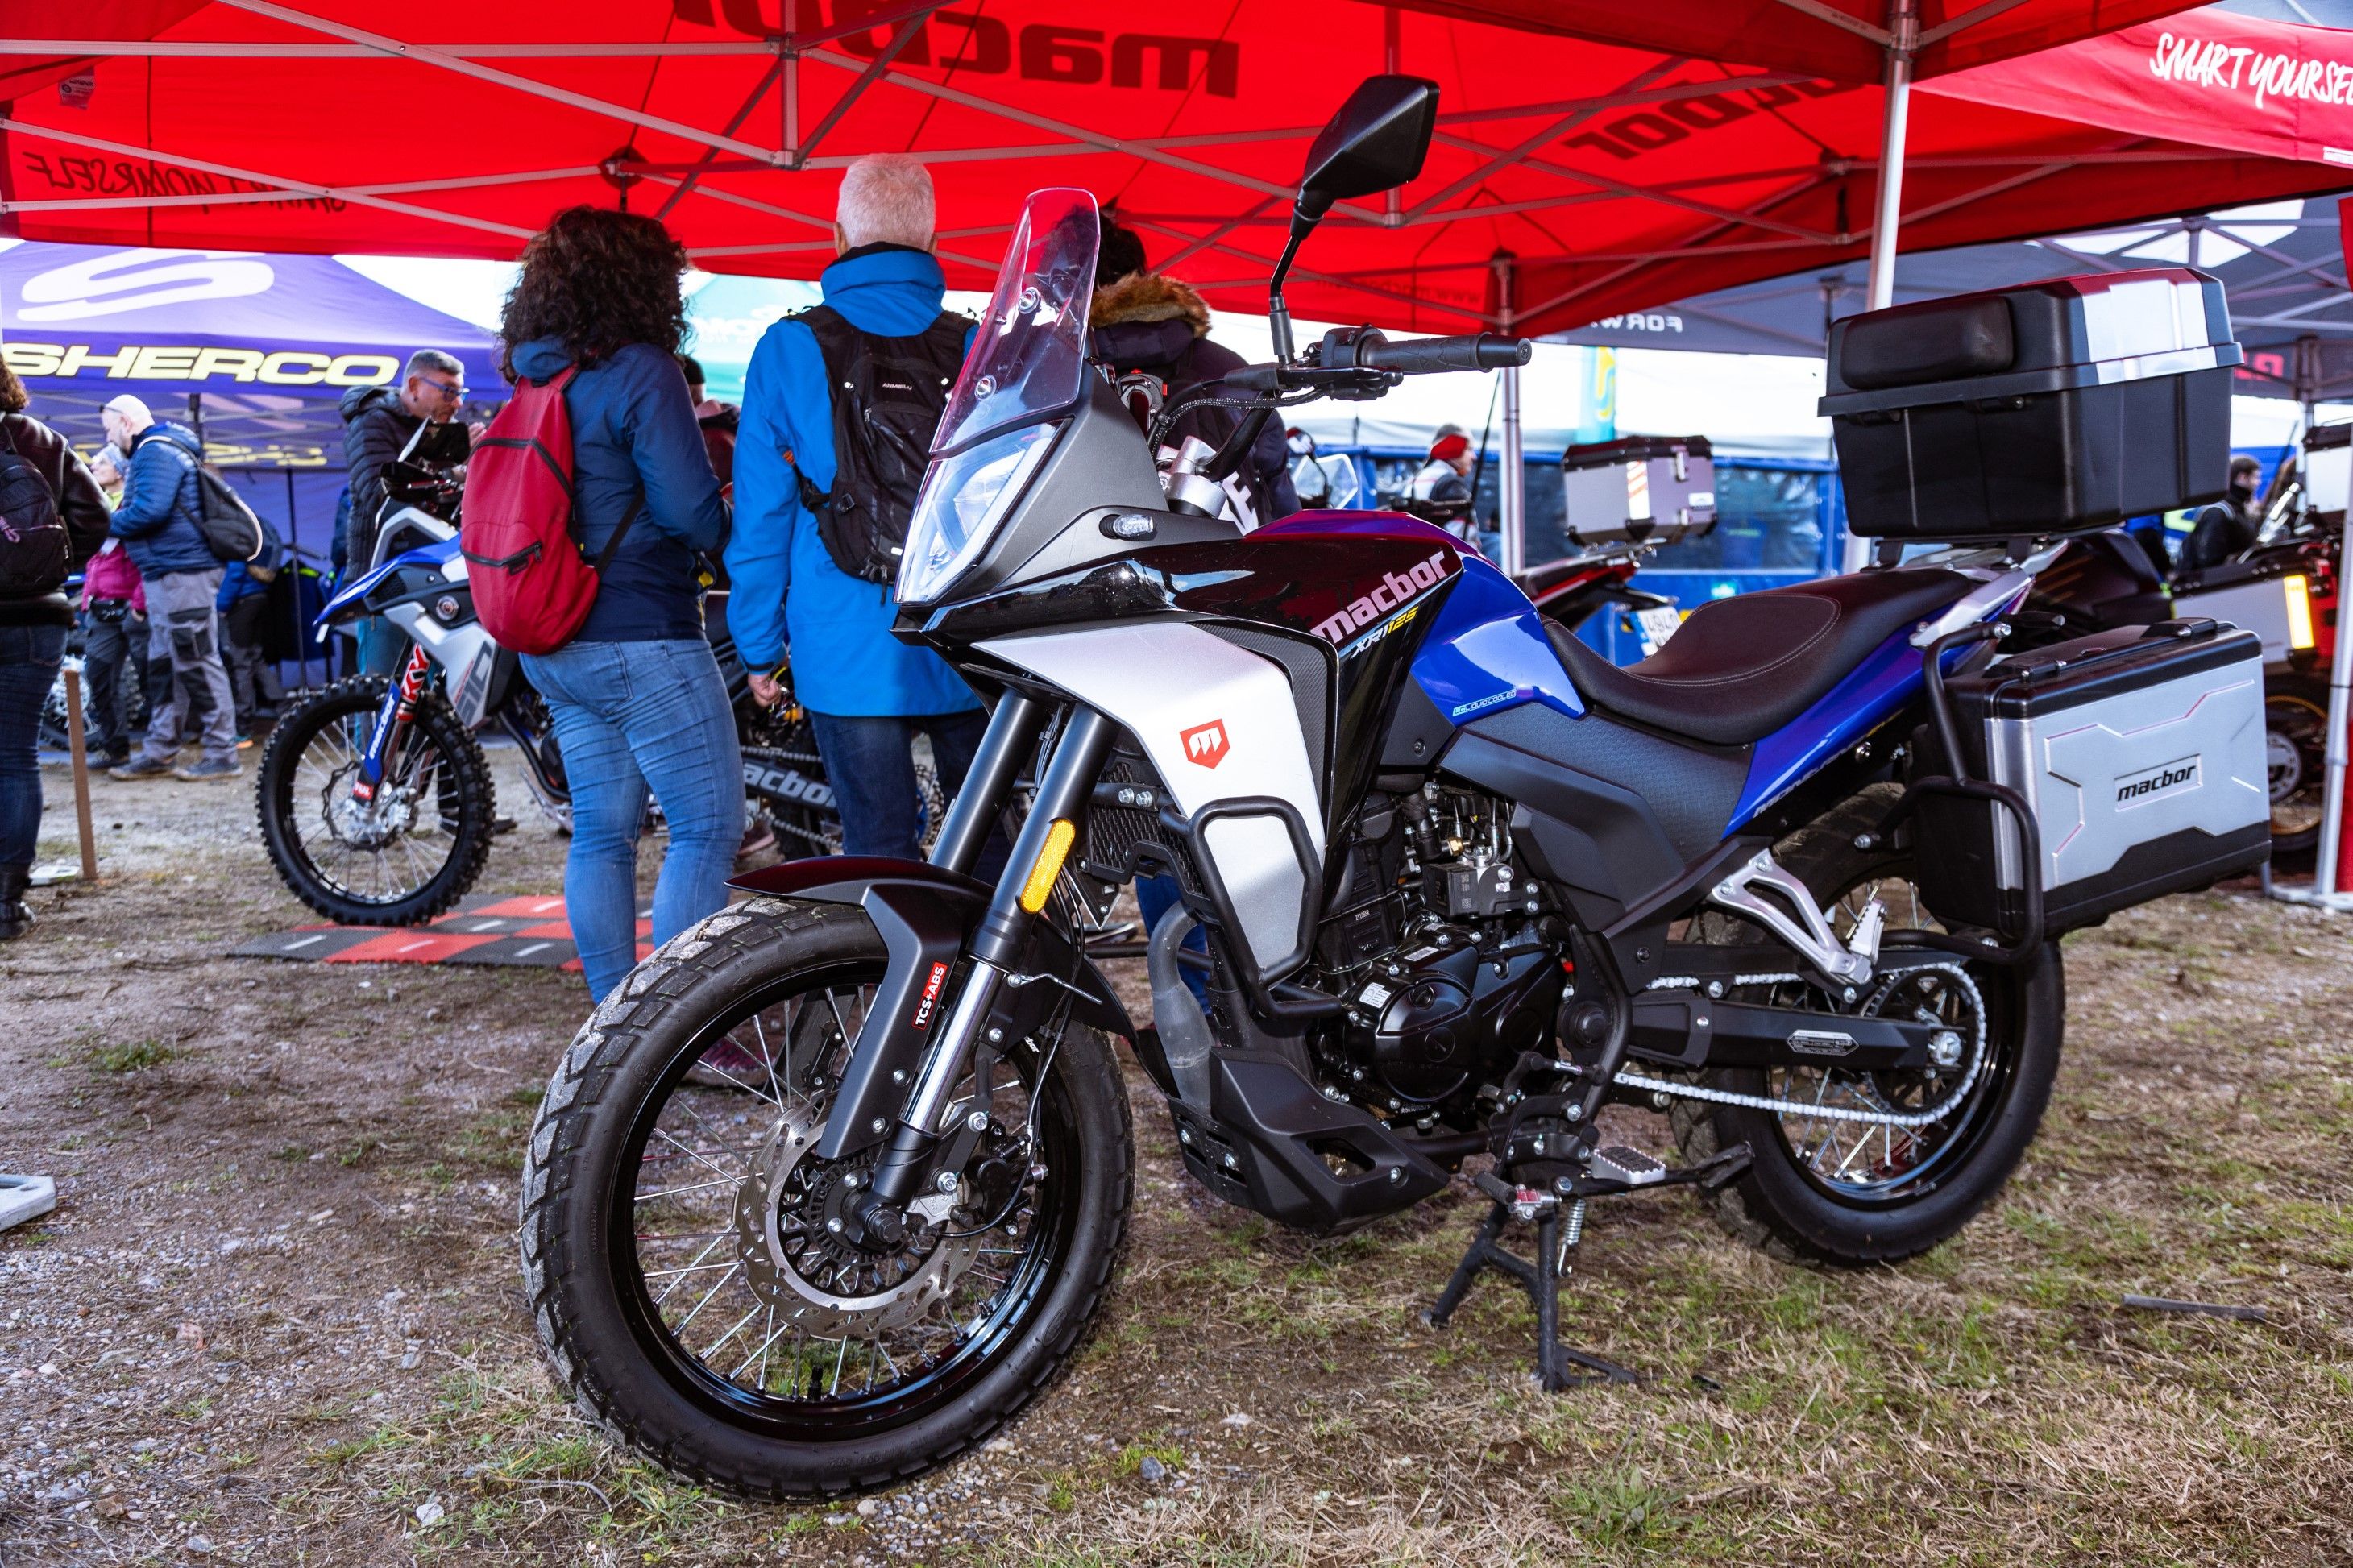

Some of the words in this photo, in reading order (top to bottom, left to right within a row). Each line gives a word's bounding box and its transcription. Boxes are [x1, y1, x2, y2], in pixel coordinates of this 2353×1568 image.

[2149, 32, 2255, 89] SMART
[0, 342, 400, 387] SHERCO
[1310, 550, 1446, 644] macbor
[400, 642, 430, 704] KY
[743, 762, 837, 808] acbo
[2117, 765, 2197, 802] macbor
[915, 966, 944, 1025] TCS+ABS
